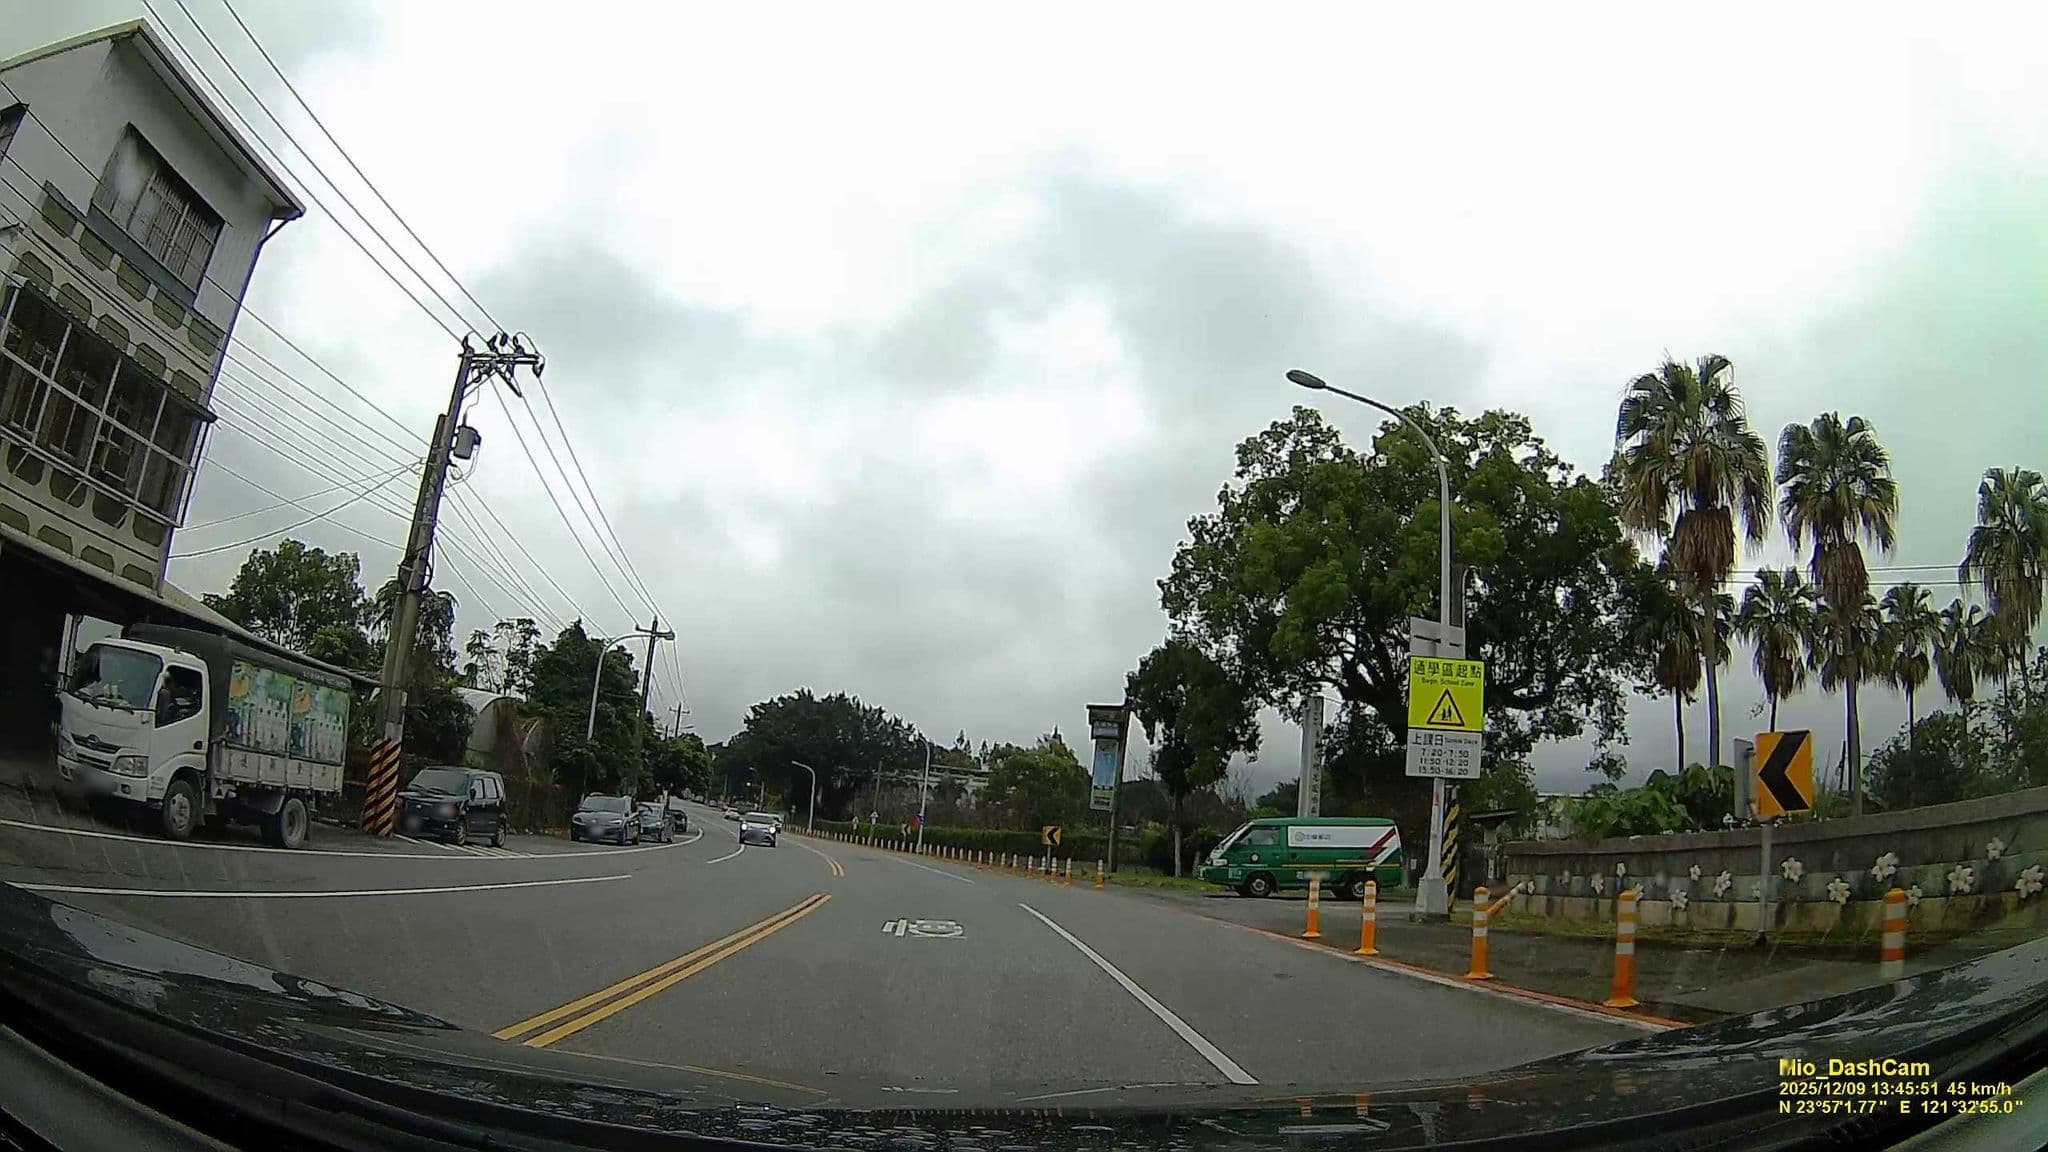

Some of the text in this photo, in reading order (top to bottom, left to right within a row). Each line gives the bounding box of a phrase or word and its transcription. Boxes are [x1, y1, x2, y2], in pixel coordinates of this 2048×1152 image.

[1414, 660, 1481, 678] 通學區起點
